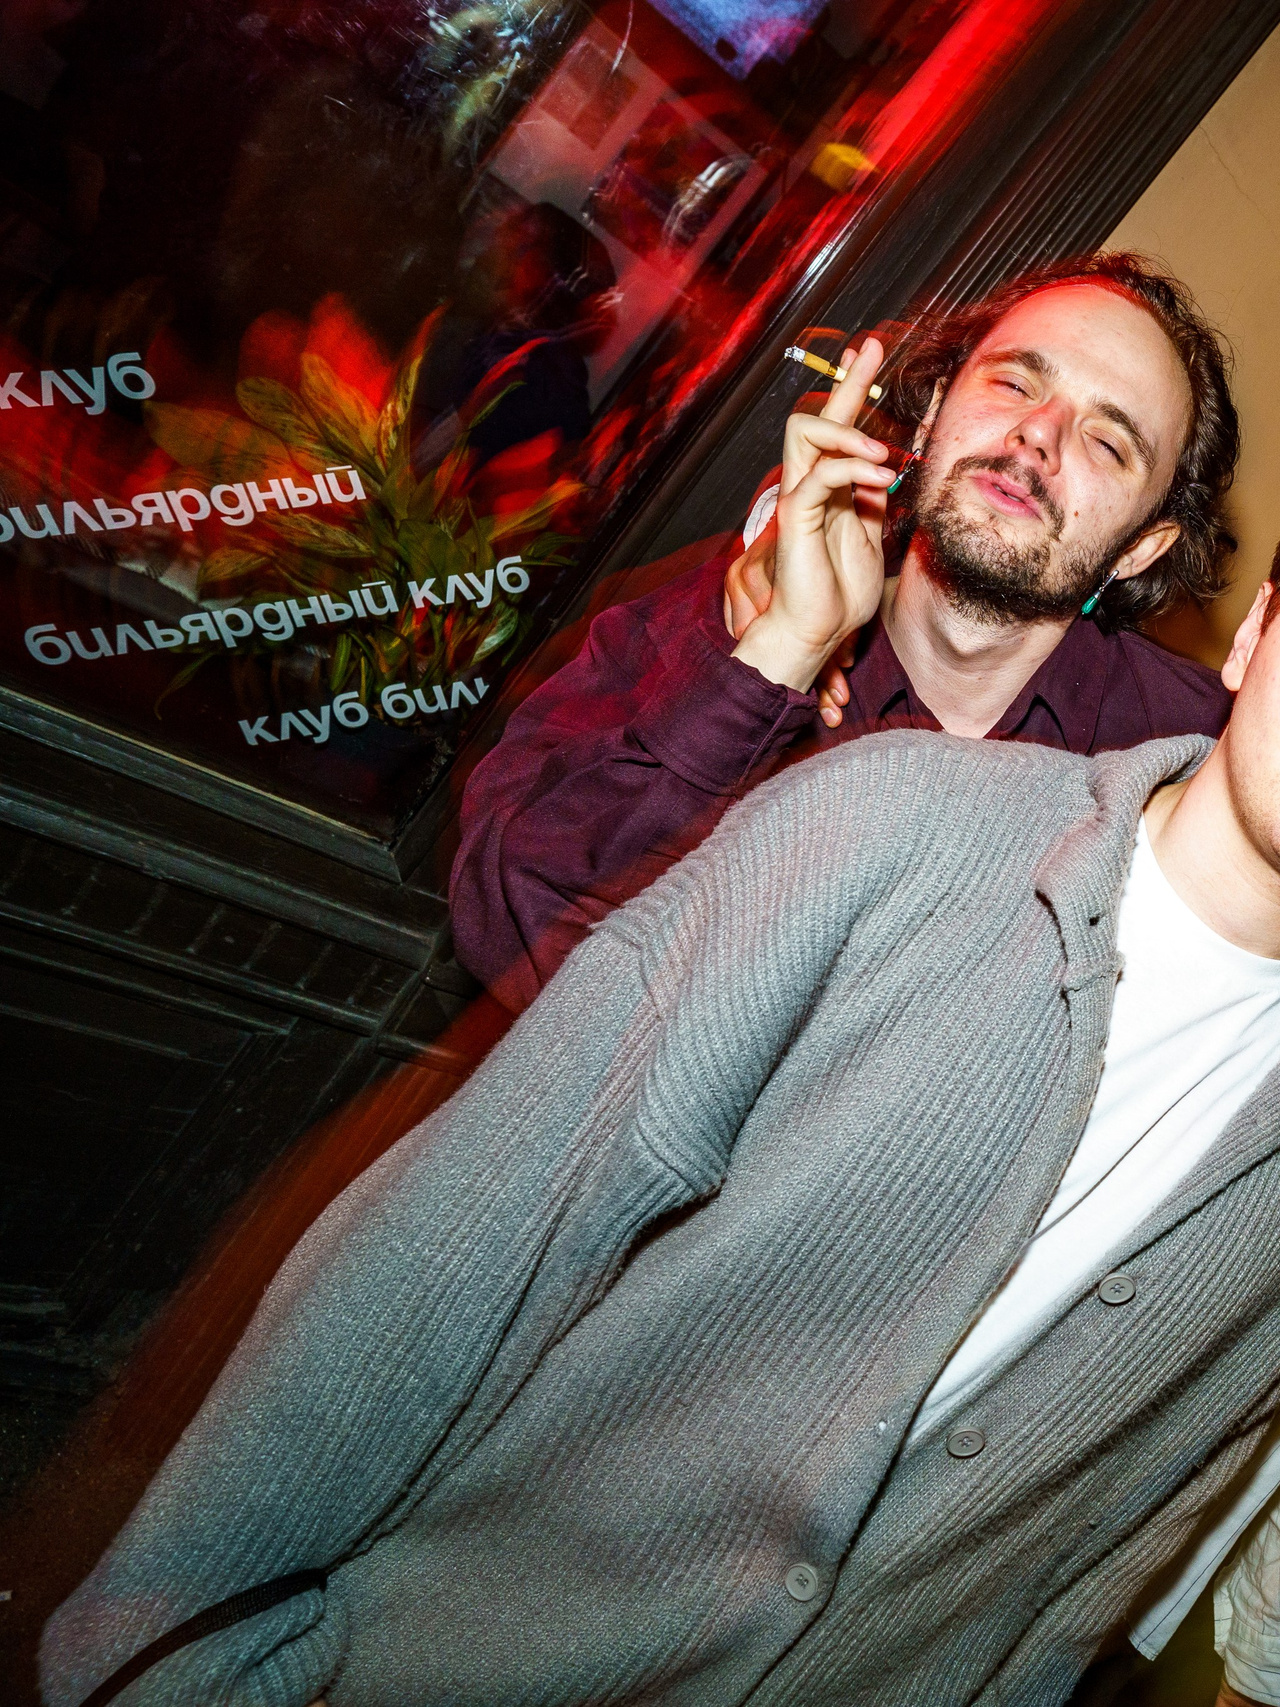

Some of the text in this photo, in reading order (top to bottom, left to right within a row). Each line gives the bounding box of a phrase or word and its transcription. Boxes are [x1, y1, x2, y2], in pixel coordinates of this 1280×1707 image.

[0, 352, 156, 416] клуб
[24, 555, 530, 664] бильярдный клуб
[238, 691, 369, 746] клуб
